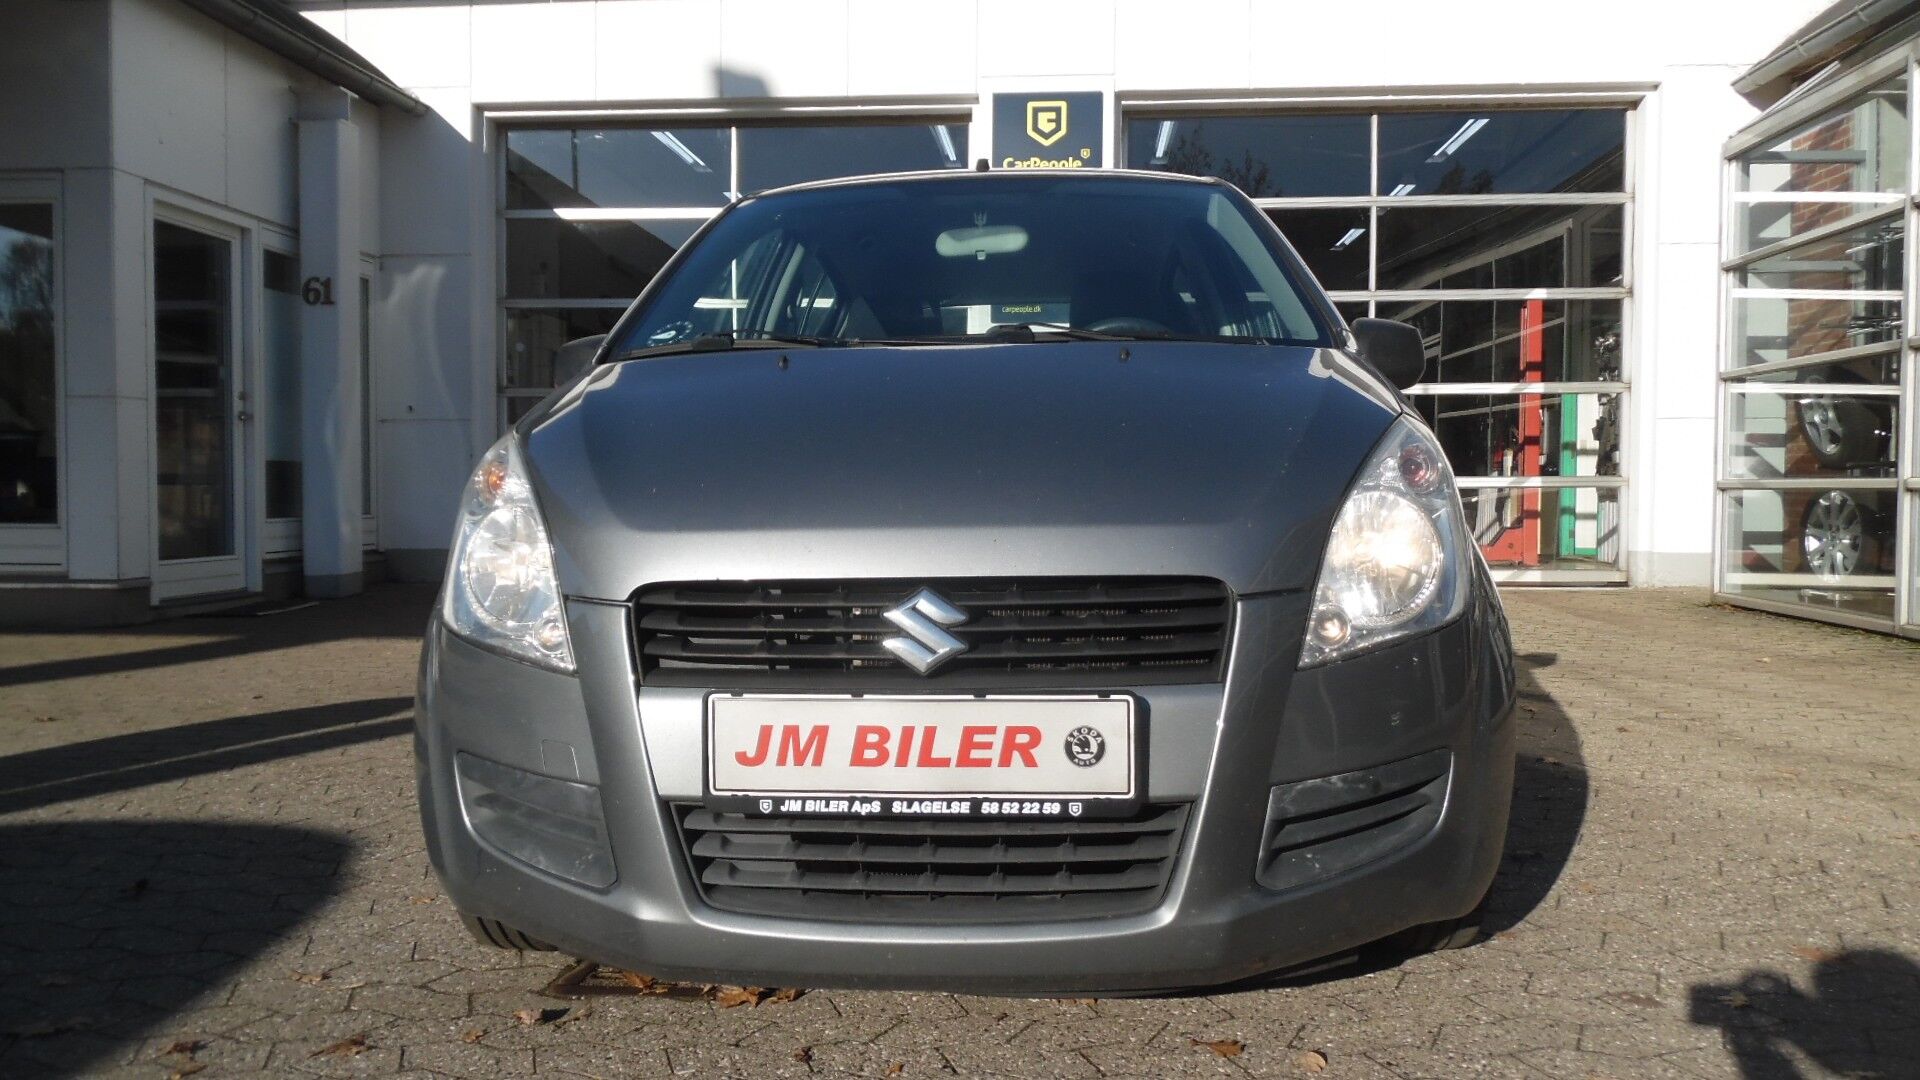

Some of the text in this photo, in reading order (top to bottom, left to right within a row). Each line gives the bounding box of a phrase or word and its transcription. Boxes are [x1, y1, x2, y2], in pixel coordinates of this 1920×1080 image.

[302, 277, 336, 306] 61
[1001, 305, 1042, 313] carpeople.dk
[734, 724, 1042, 768] JM BILER
[780, 799, 1061, 815] JM BILER ApS SLAGELSE 58 52 22 59
